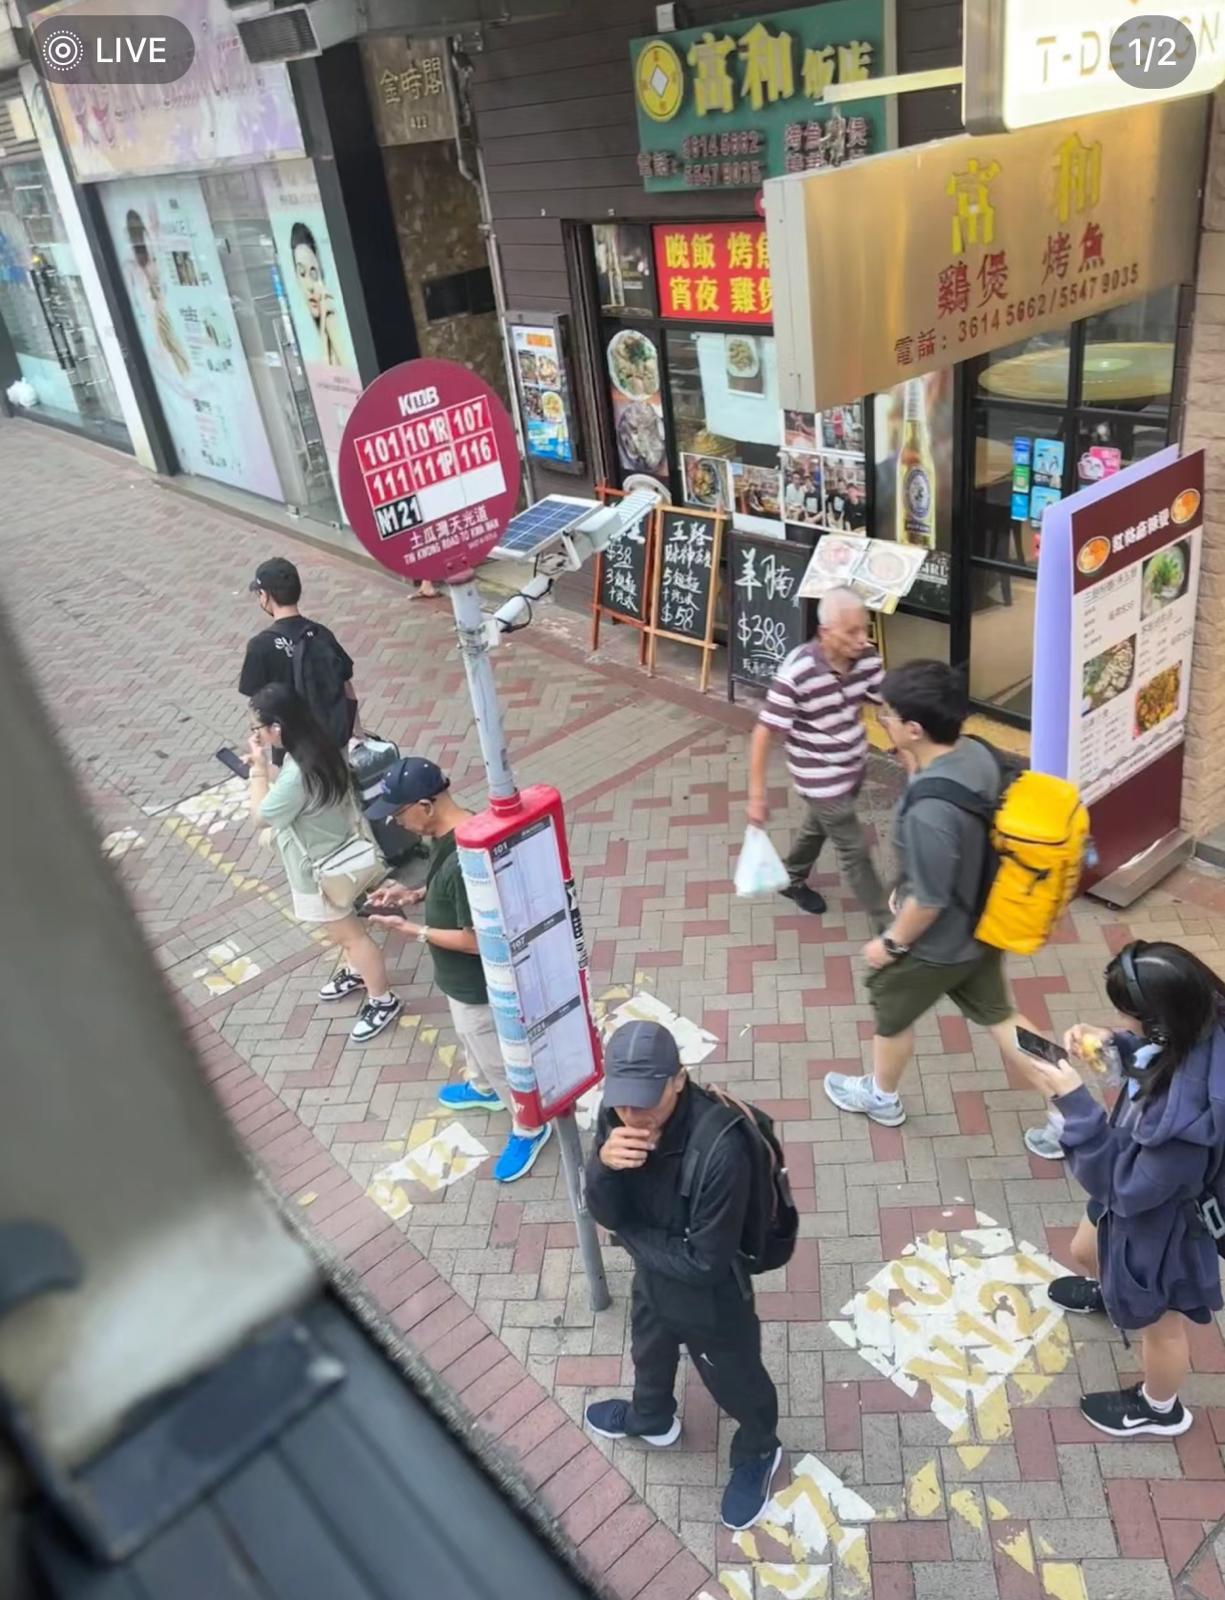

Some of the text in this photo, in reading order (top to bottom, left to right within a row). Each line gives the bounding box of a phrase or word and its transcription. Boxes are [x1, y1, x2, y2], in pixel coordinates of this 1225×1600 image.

[664, 232, 717, 269] 晚飯
[1041, 222, 1105, 286] 烤魚
[669, 275, 719, 312] 宵夜
[364, 402, 484, 467] 101 101R 107
[373, 436, 492, 501] 111 111P 116
[376, 496, 422, 536] N121
[735, 547, 795, 601] 羊腩
[661, 602, 694, 632] $58
[738, 611, 788, 662] $388
